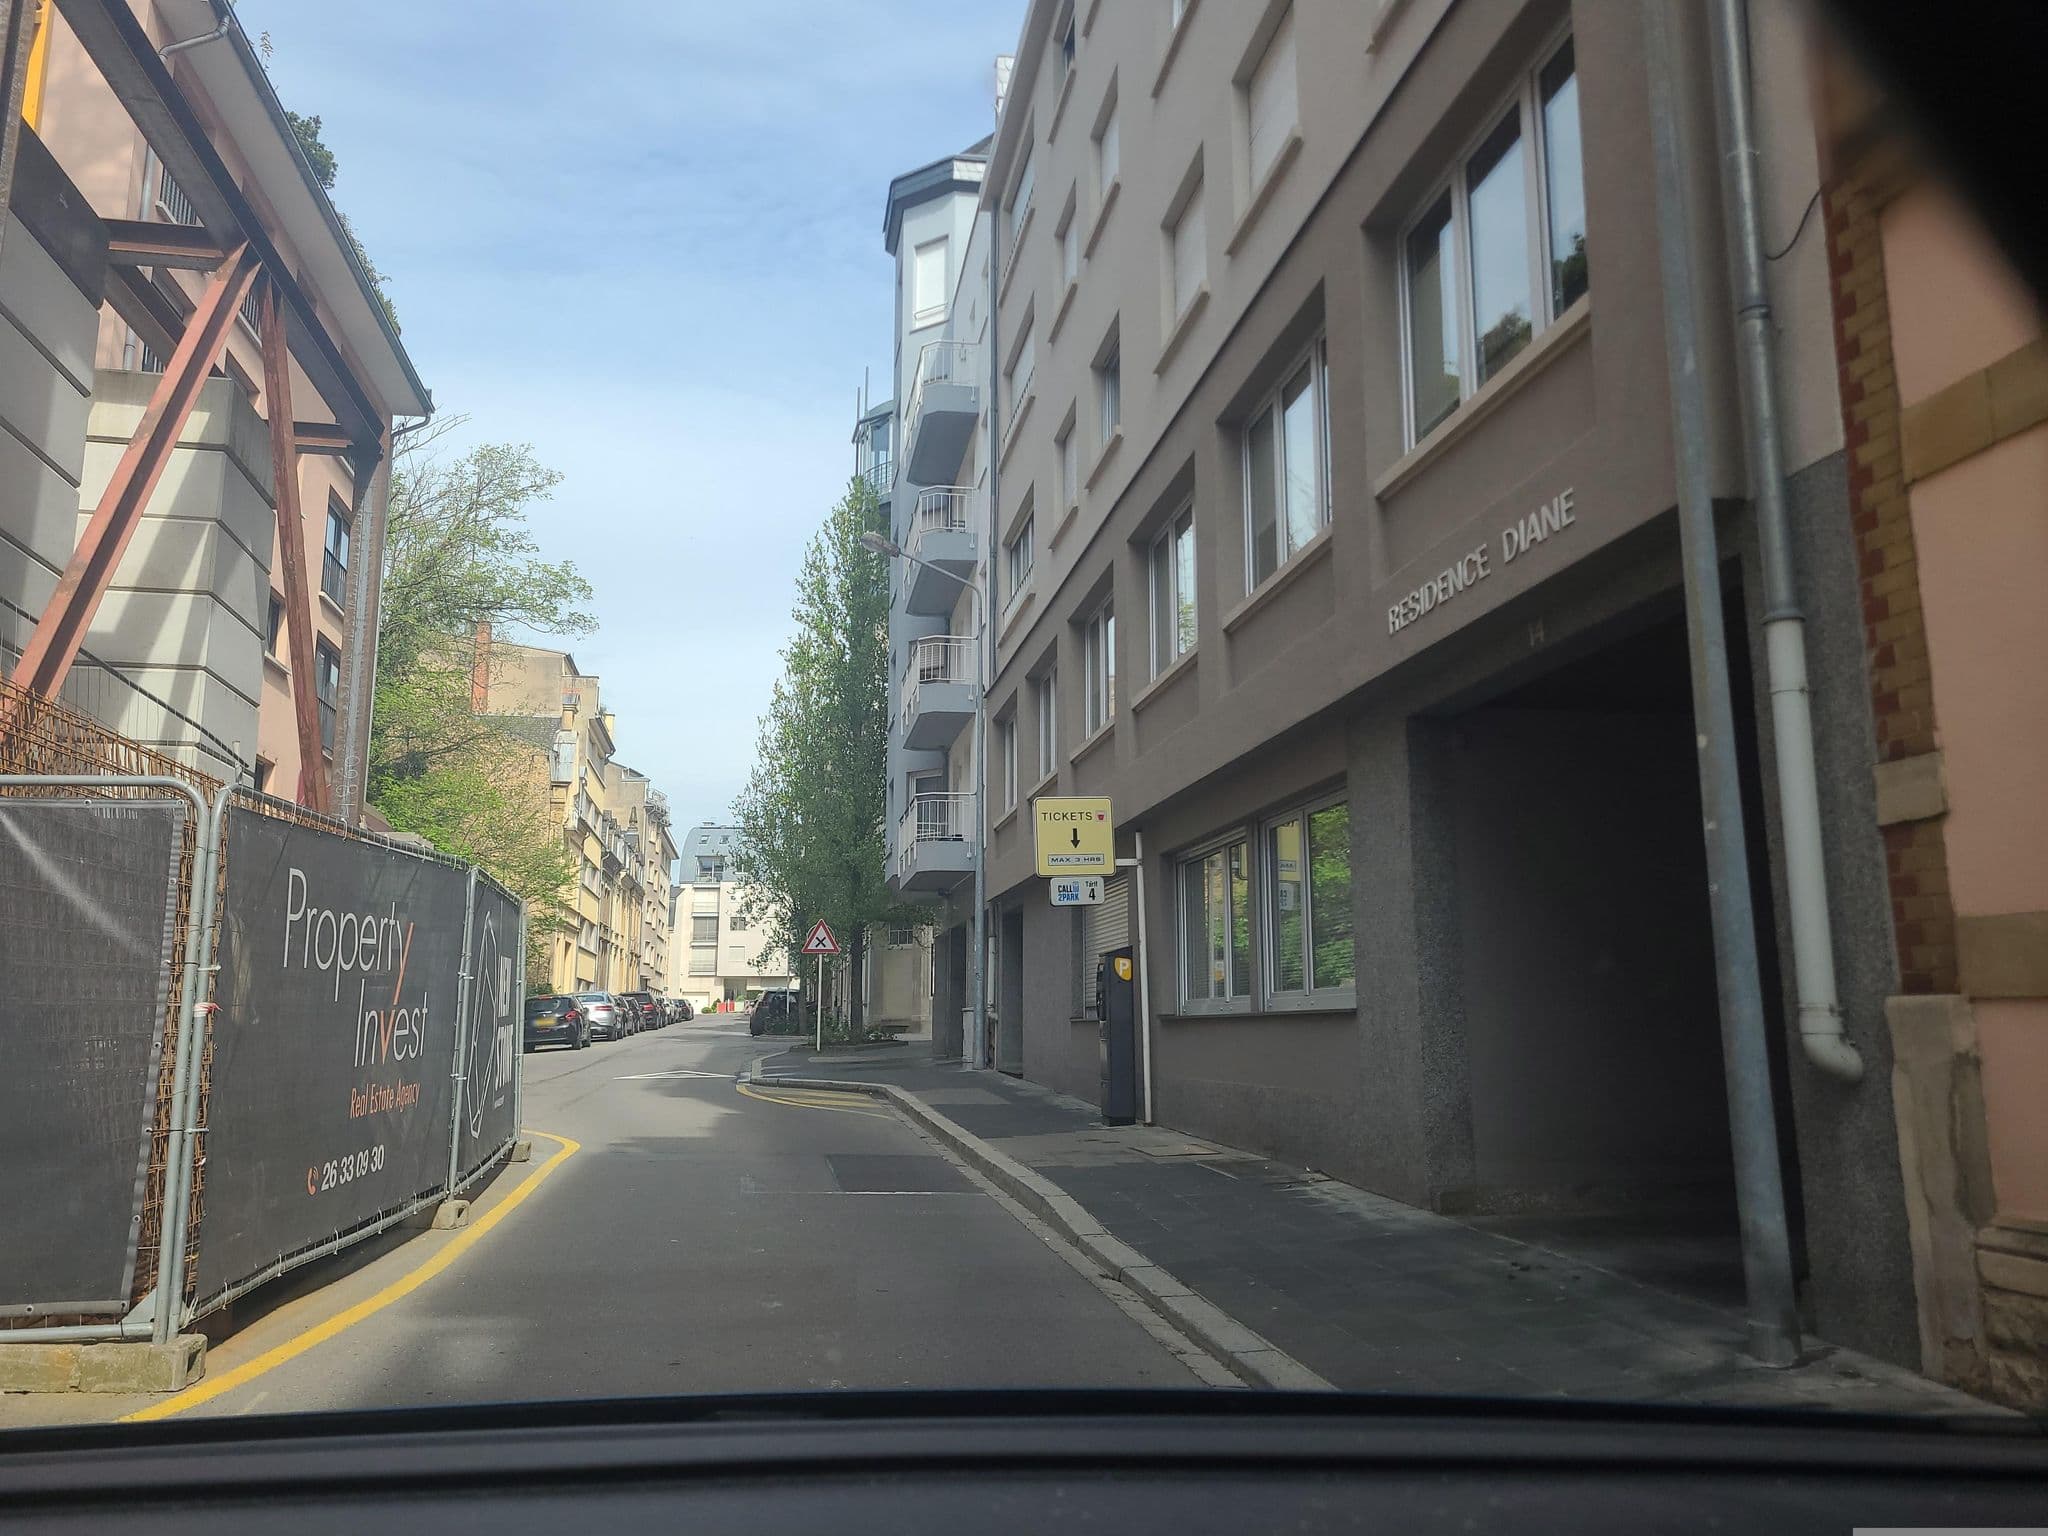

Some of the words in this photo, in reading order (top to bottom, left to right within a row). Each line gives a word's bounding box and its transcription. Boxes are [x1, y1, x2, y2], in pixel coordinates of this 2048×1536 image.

[1388, 543, 1491, 635] RESIDENCE
[1502, 487, 1576, 564] DIANE
[1041, 811, 1093, 821] TICKETS
[1057, 884, 1073, 893] CALL
[1088, 888, 1096, 901] 4
[283, 867, 415, 1006] Property
[1119, 959, 1129, 977] P
[354, 978, 428, 1068] Invest
[350, 1083, 369, 1119] Real
[370, 1083, 394, 1113] Estate
[321, 1159, 338, 1191] 26
[340, 1154, 354, 1185] 33
[356, 1149, 369, 1178] 09
[371, 1144, 385, 1172] 30
